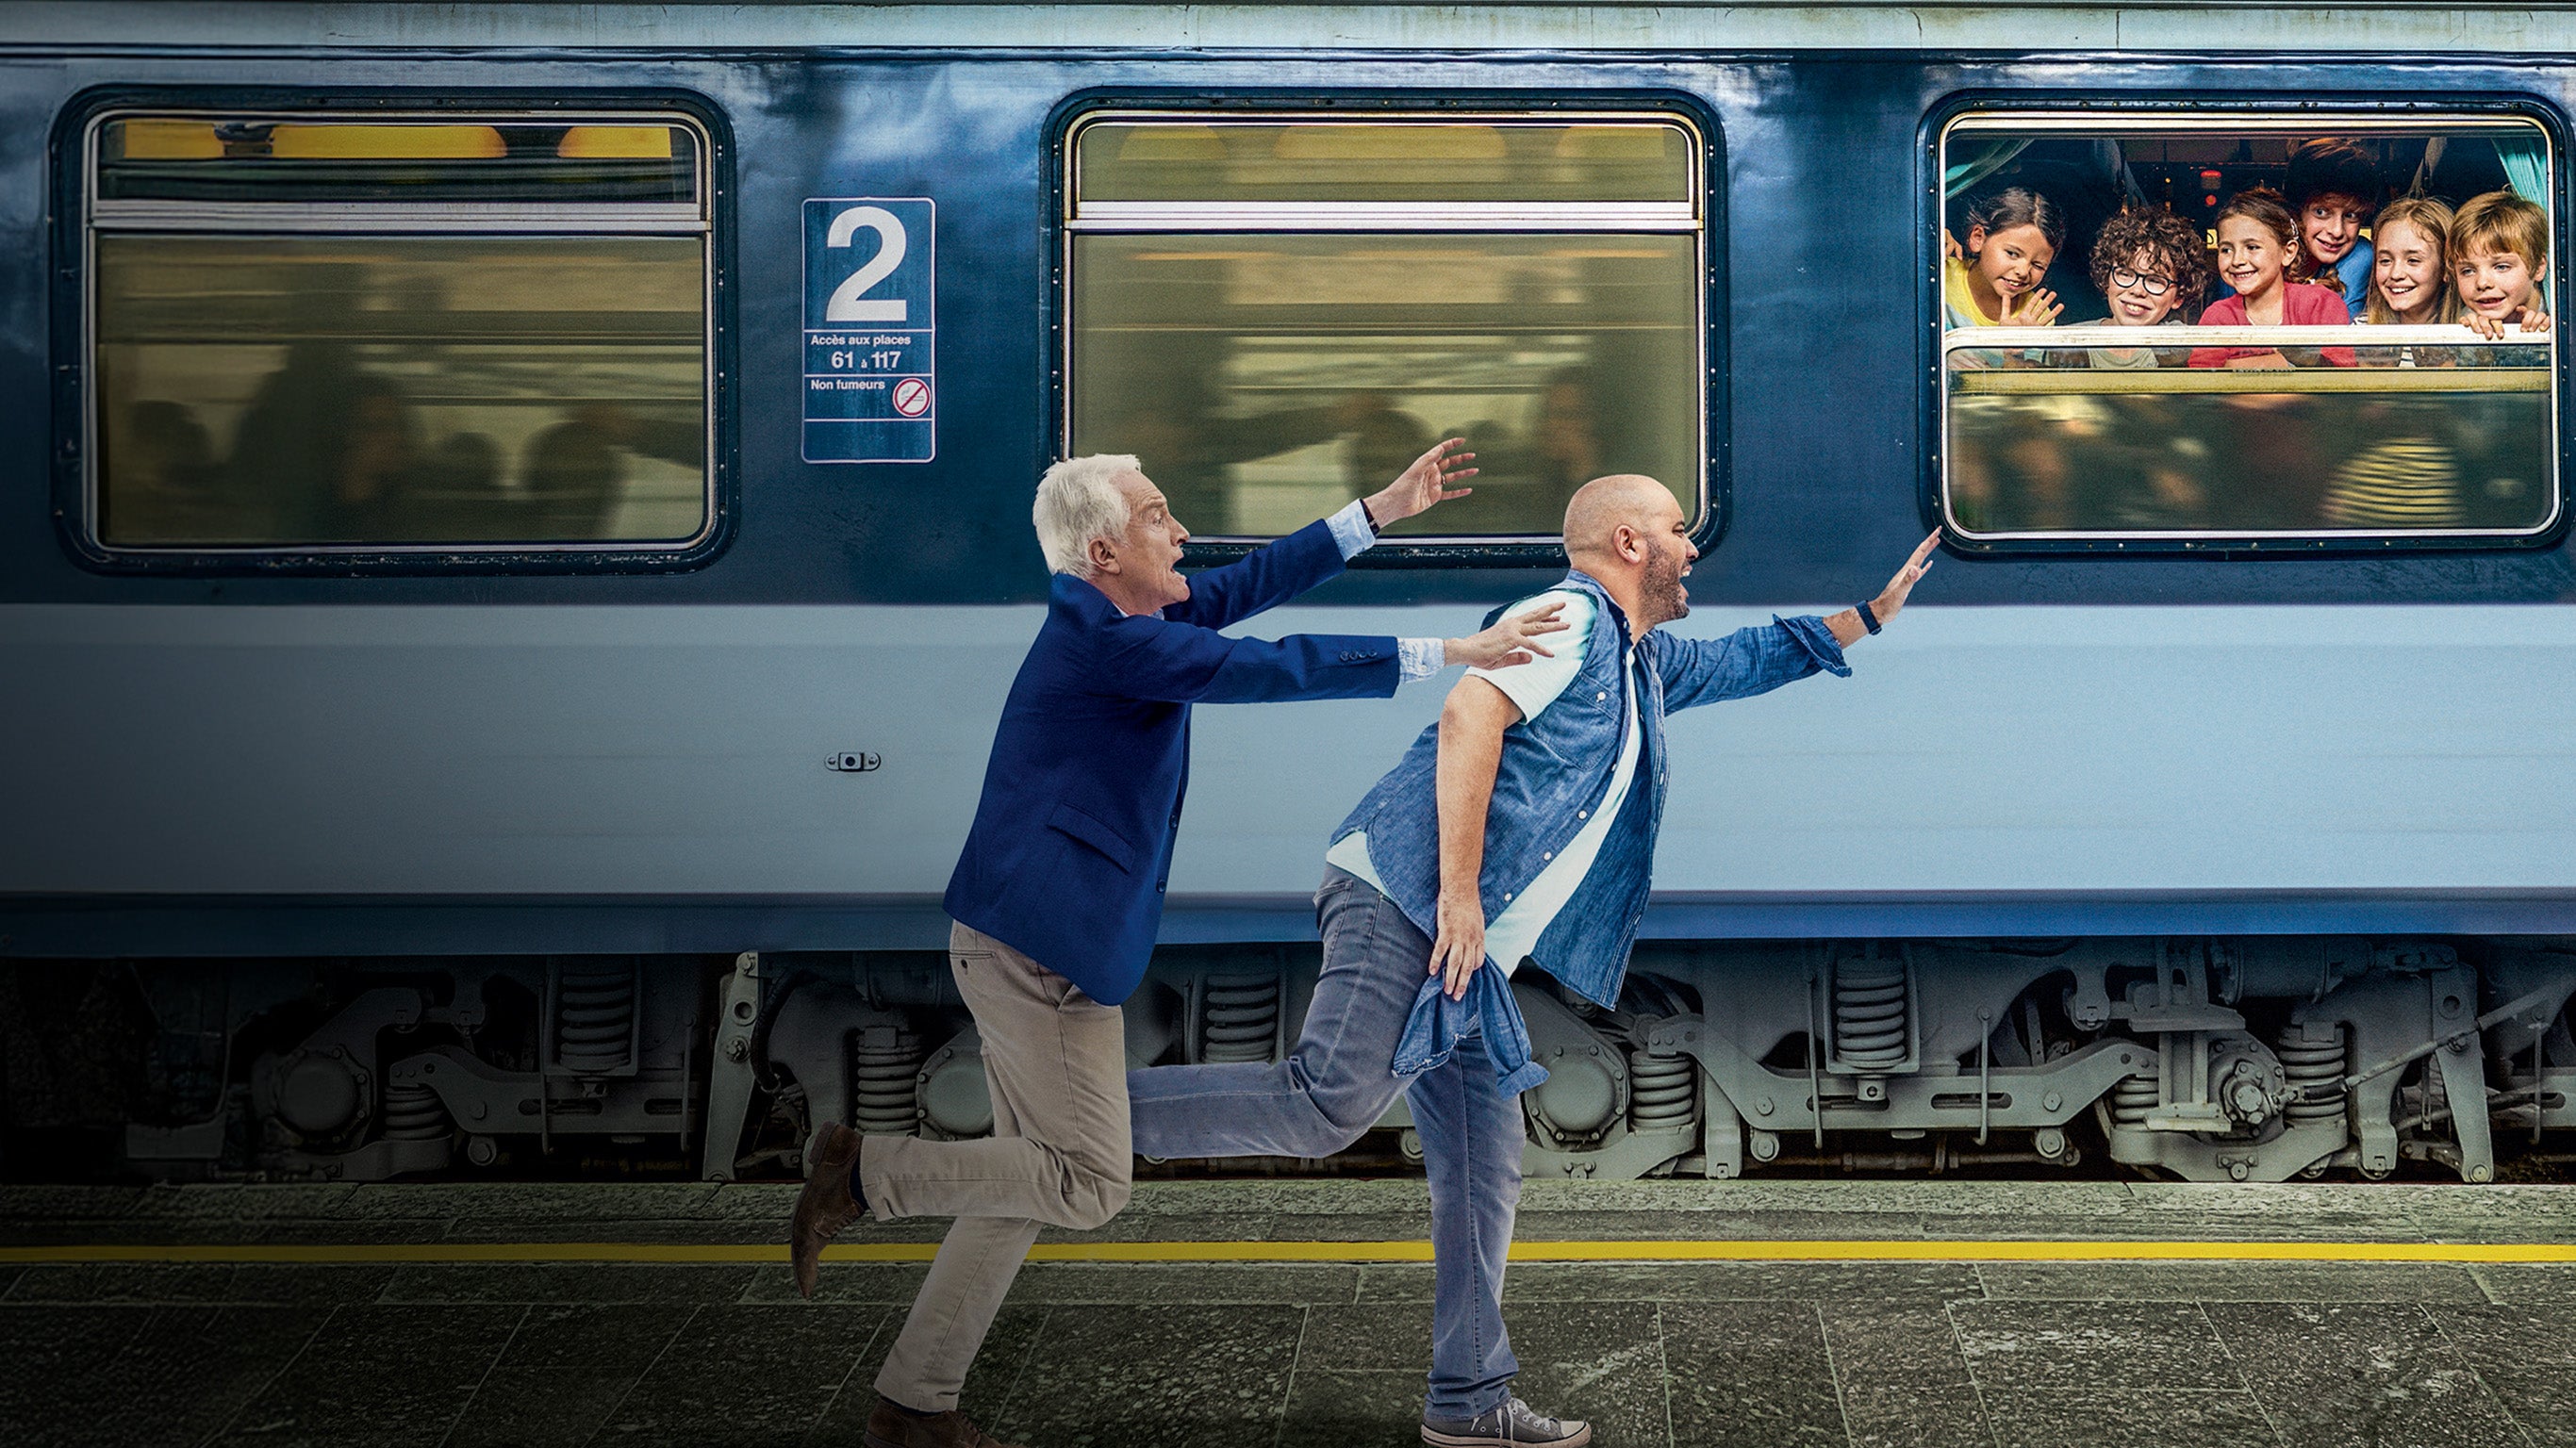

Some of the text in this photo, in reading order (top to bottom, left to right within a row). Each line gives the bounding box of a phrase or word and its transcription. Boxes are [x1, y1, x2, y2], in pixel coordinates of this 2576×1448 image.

[825, 206, 907, 321] 2
[811, 335, 912, 348] Accès aux places
[831, 351, 853, 369] 61
[871, 351, 901, 369] 117
[811, 379, 885, 390] Non fumeurs
